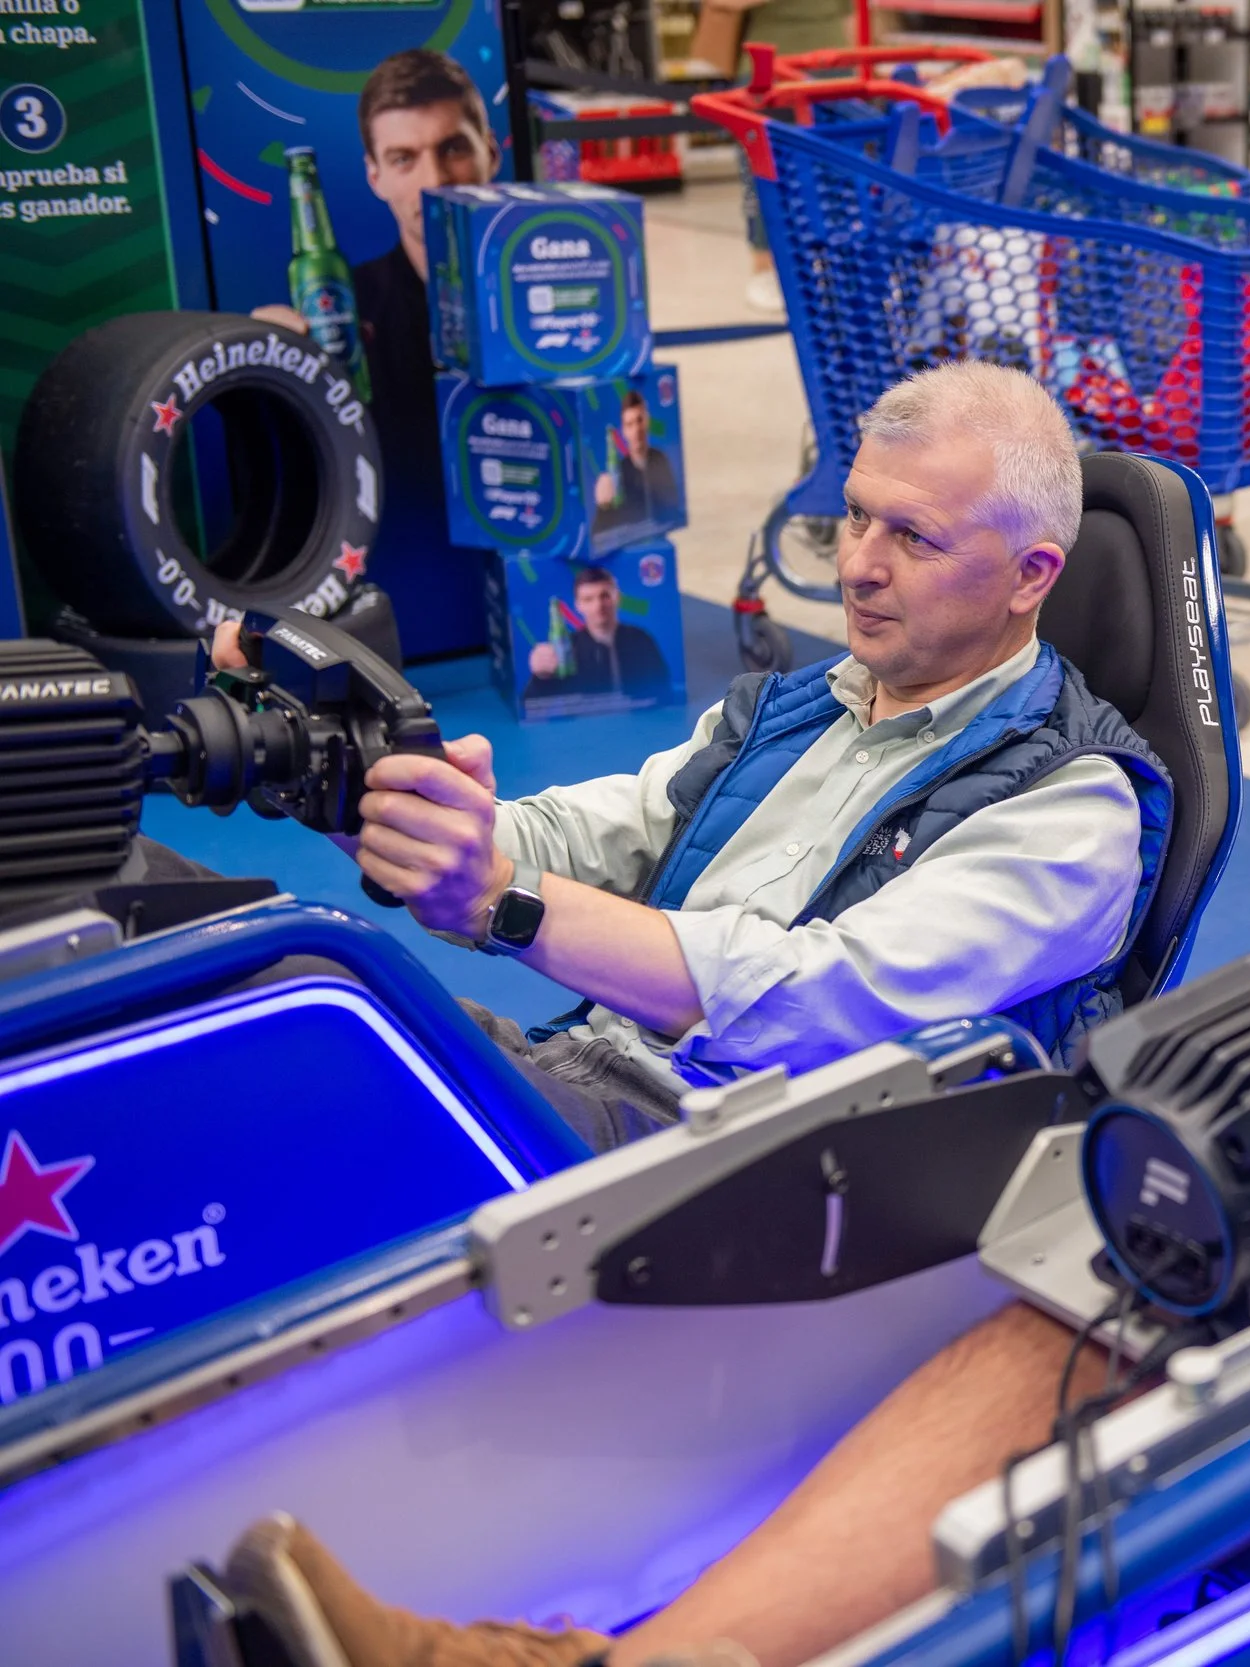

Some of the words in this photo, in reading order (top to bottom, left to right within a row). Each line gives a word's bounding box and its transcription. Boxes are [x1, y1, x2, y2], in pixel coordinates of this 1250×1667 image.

[10, 21, 97, 49] chapa.
[15, 96, 47, 139] 3
[103, 160, 128, 184] si
[20, 192, 132, 223] ganador.
[530, 236, 591, 260] Gana
[482, 412, 533, 439] Gana
[274, 627, 328, 661] FANATEC
[0, 679, 111, 702] ANATEC
